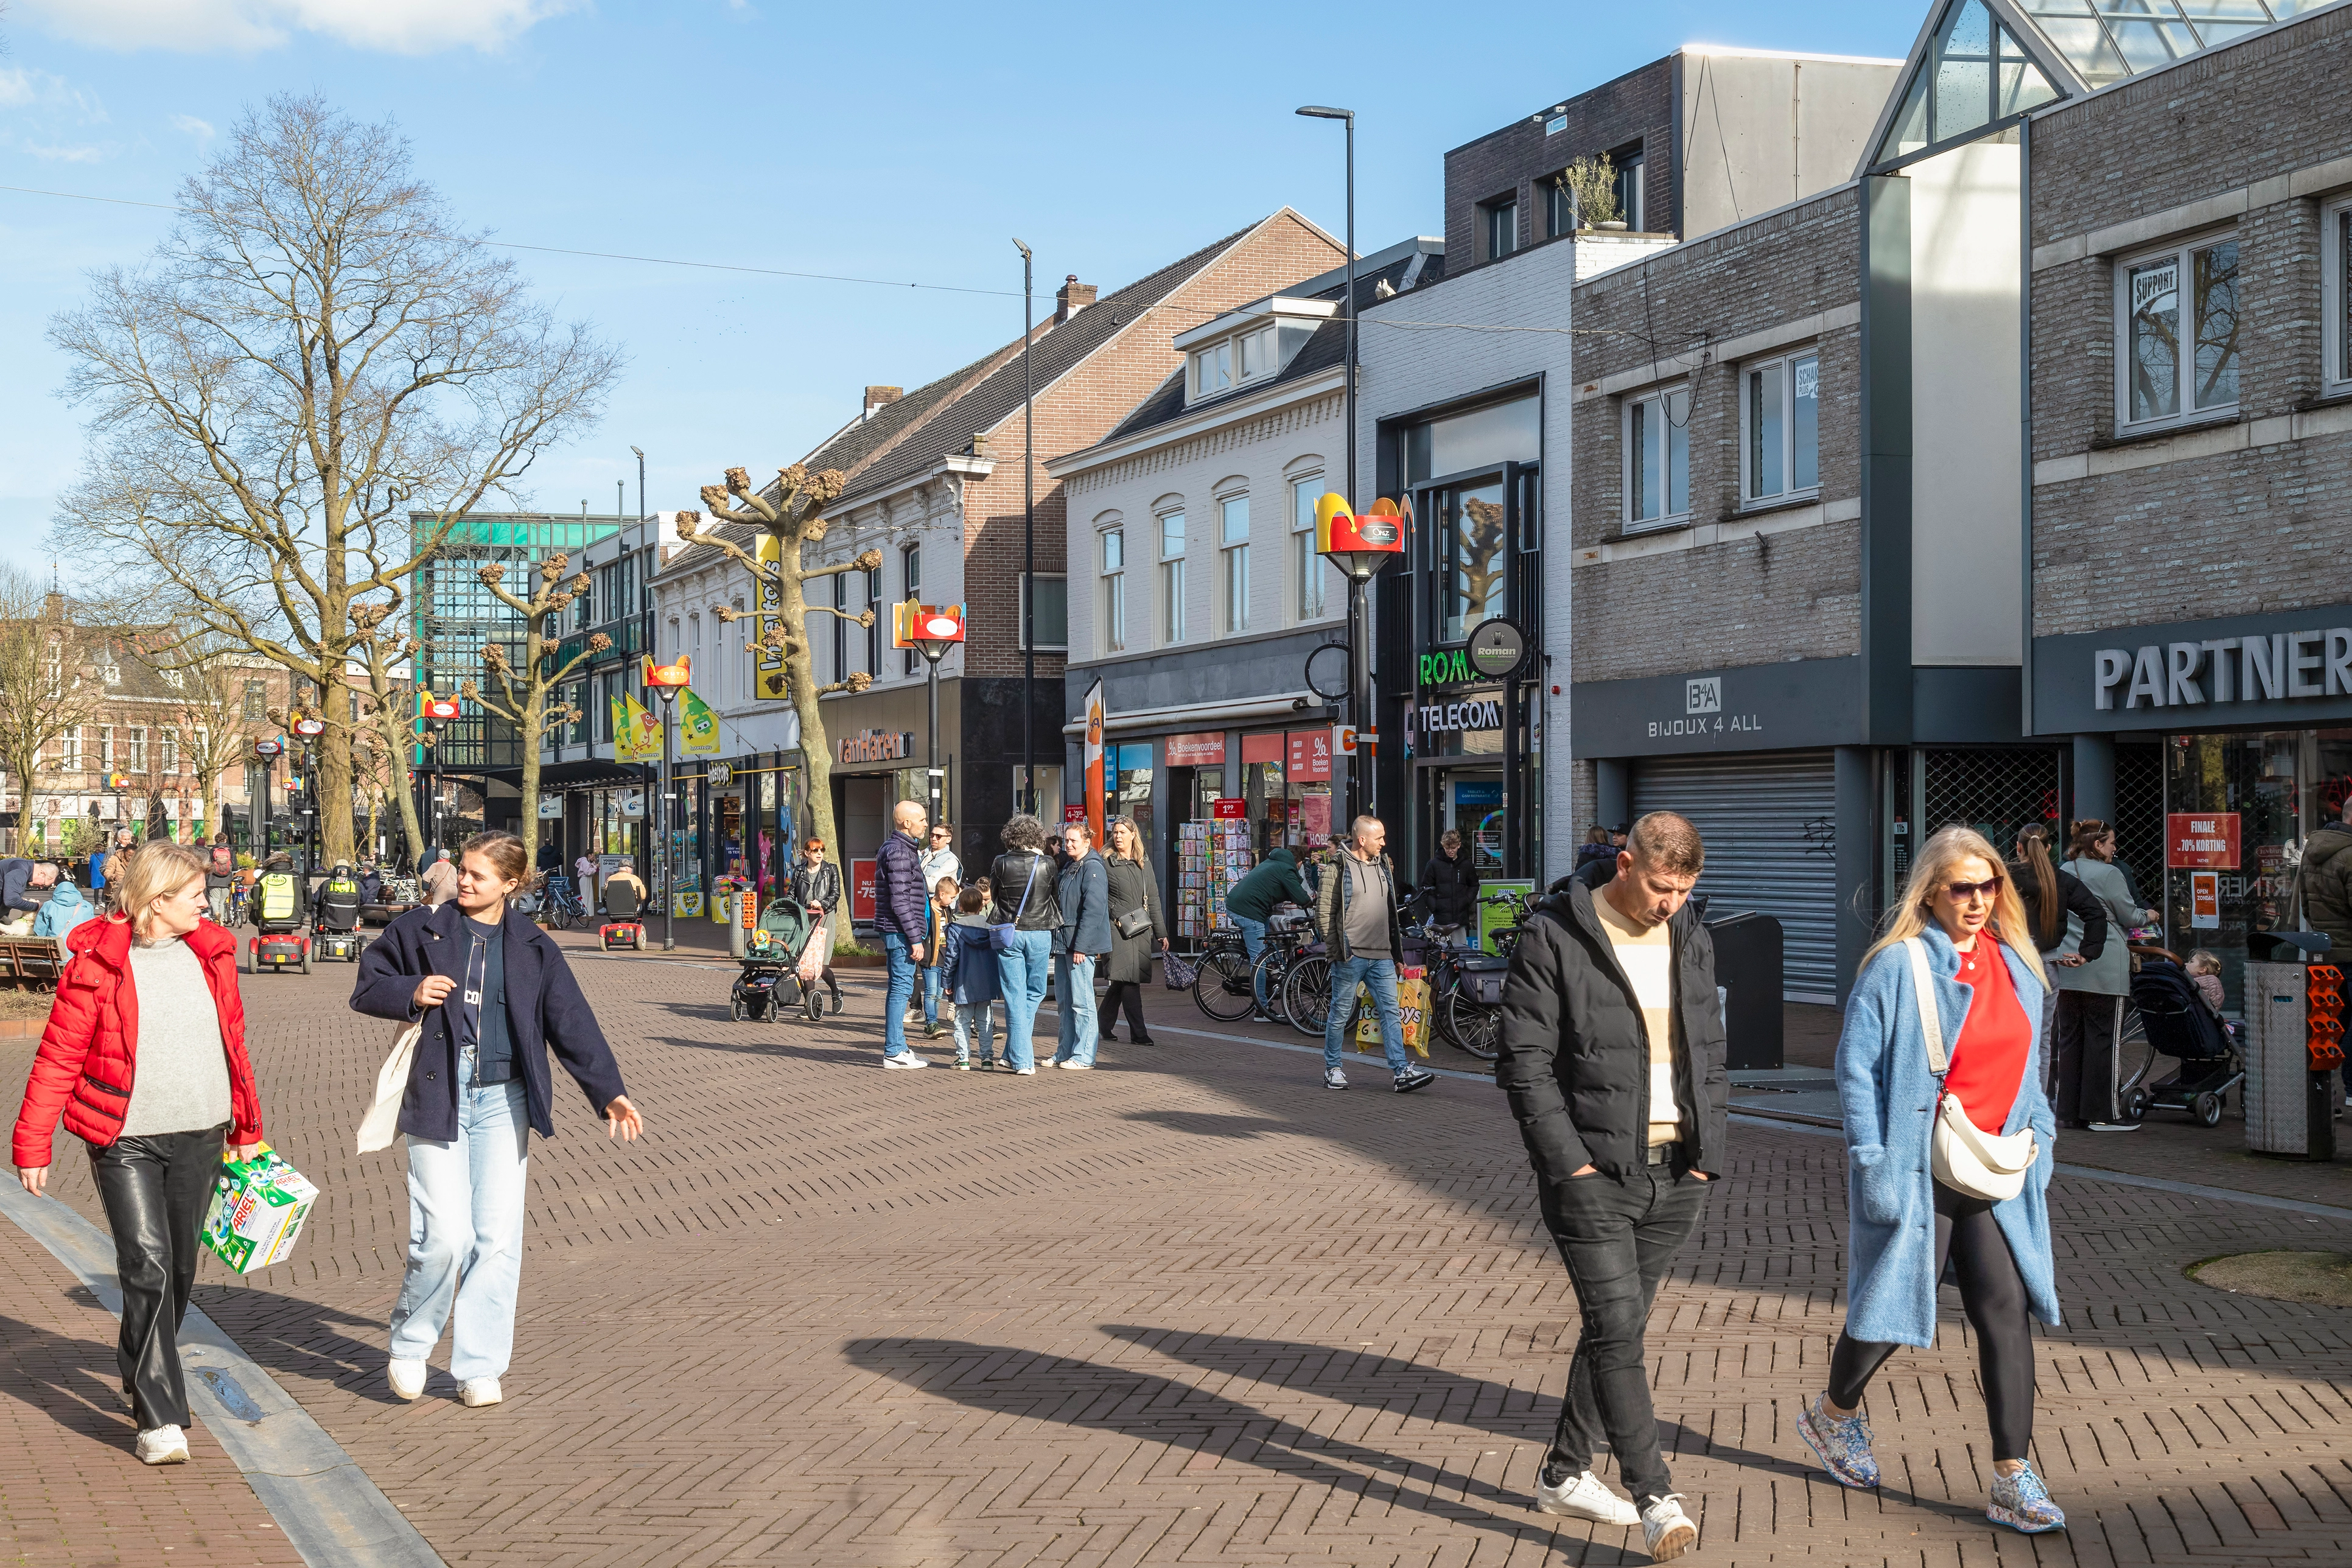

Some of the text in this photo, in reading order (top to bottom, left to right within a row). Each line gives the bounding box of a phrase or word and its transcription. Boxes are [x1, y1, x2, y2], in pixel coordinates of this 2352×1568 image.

[2136, 270, 2174, 305] SUPPORT
[1799, 365, 1818, 385] SCHAK
[1799, 385, 1809, 396] PLUS
[759, 560, 782, 671] Inertos
[1420, 649, 1485, 685] ROM
[2095, 628, 2352, 710] PARTNER
[1419, 700, 1499, 732] TELECOM
[1648, 715, 1762, 737] BIJOUX 4 ALL
[837, 729, 902, 763] vanHaren
[1177, 740, 1222, 752] Boekenvoordeel
[707, 763, 730, 783] Intertoys
[2191, 821, 2216, 833] FINALE
[2181, 839, 2196, 852] 70%
[2196, 839, 2226, 852] KORTING
[684, 893, 698, 901] Stunt
[464, 990, 480, 1005] CO
[276, 1175, 300, 1186] ARIEL
[233, 1196, 255, 1231] ARIEL
